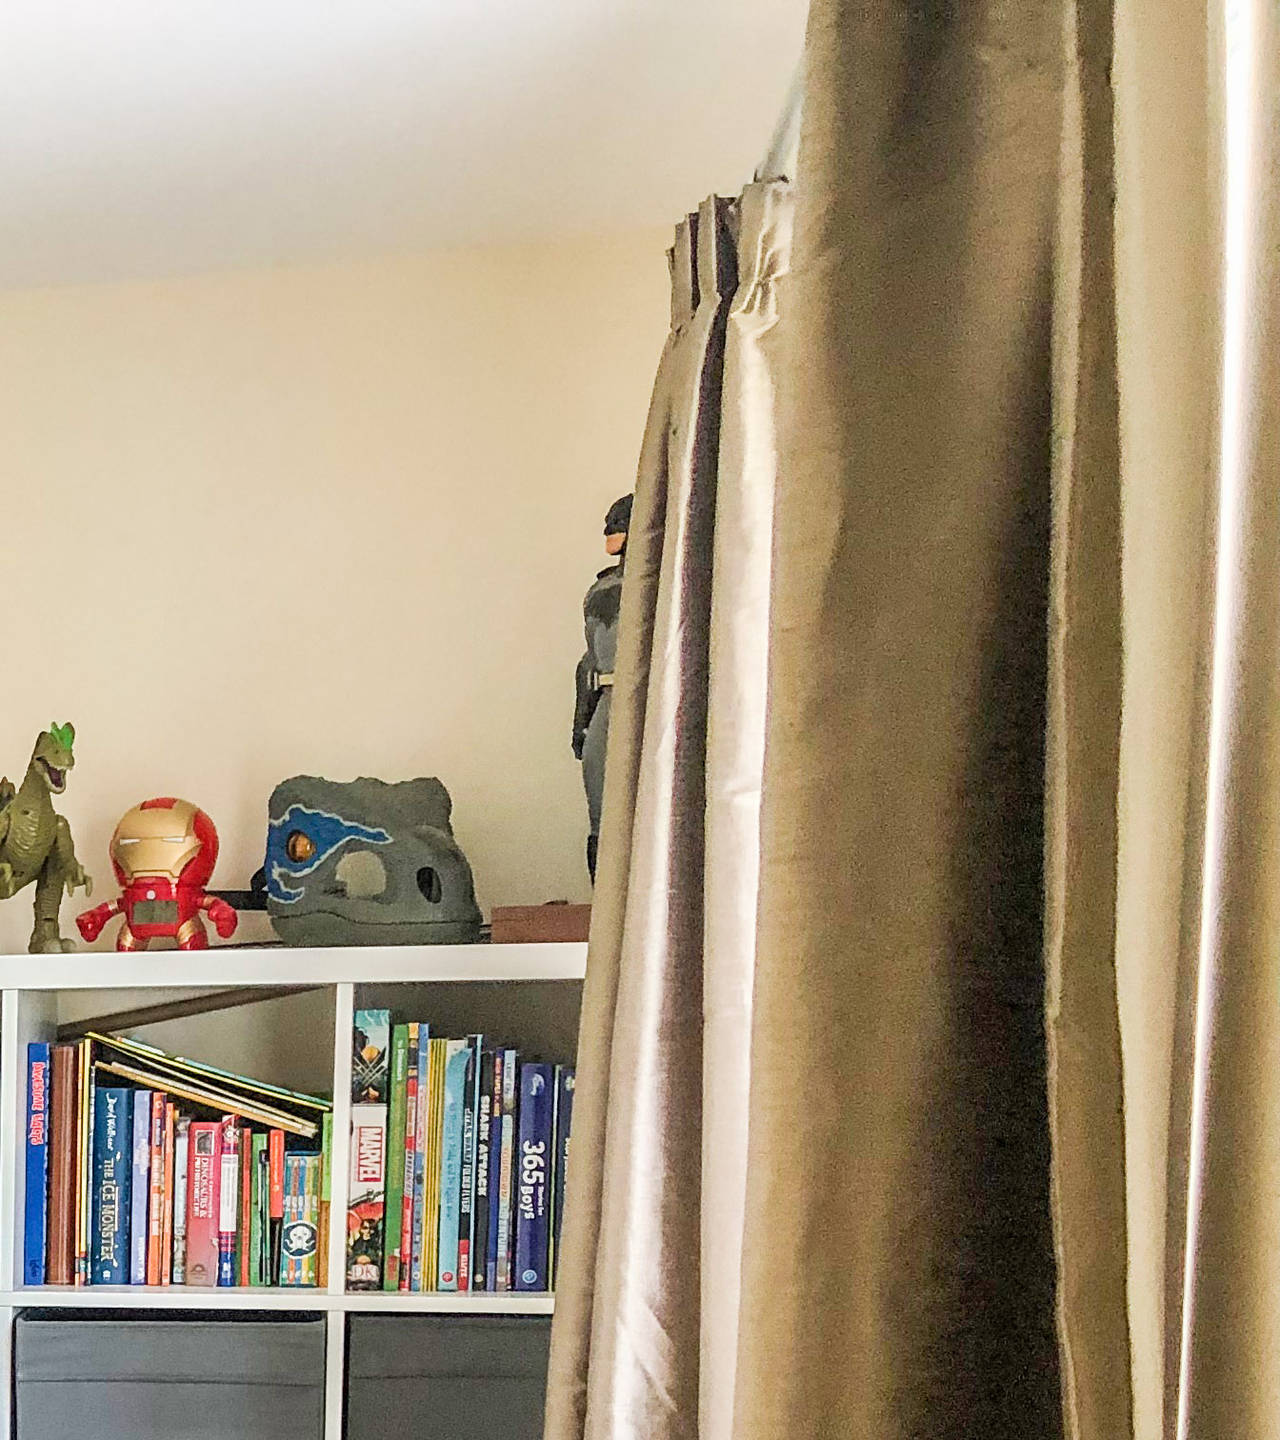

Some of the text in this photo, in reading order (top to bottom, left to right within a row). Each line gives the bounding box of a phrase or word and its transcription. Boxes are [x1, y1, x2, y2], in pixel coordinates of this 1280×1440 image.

[359, 1126, 383, 1182] MARVEL
[478, 1095, 490, 1196] SHARK ATTACK
[522, 1140, 545, 1185] 365
[100, 1158, 116, 1263] THE ICE MONSTER
[521, 1185, 535, 1220] Boys
